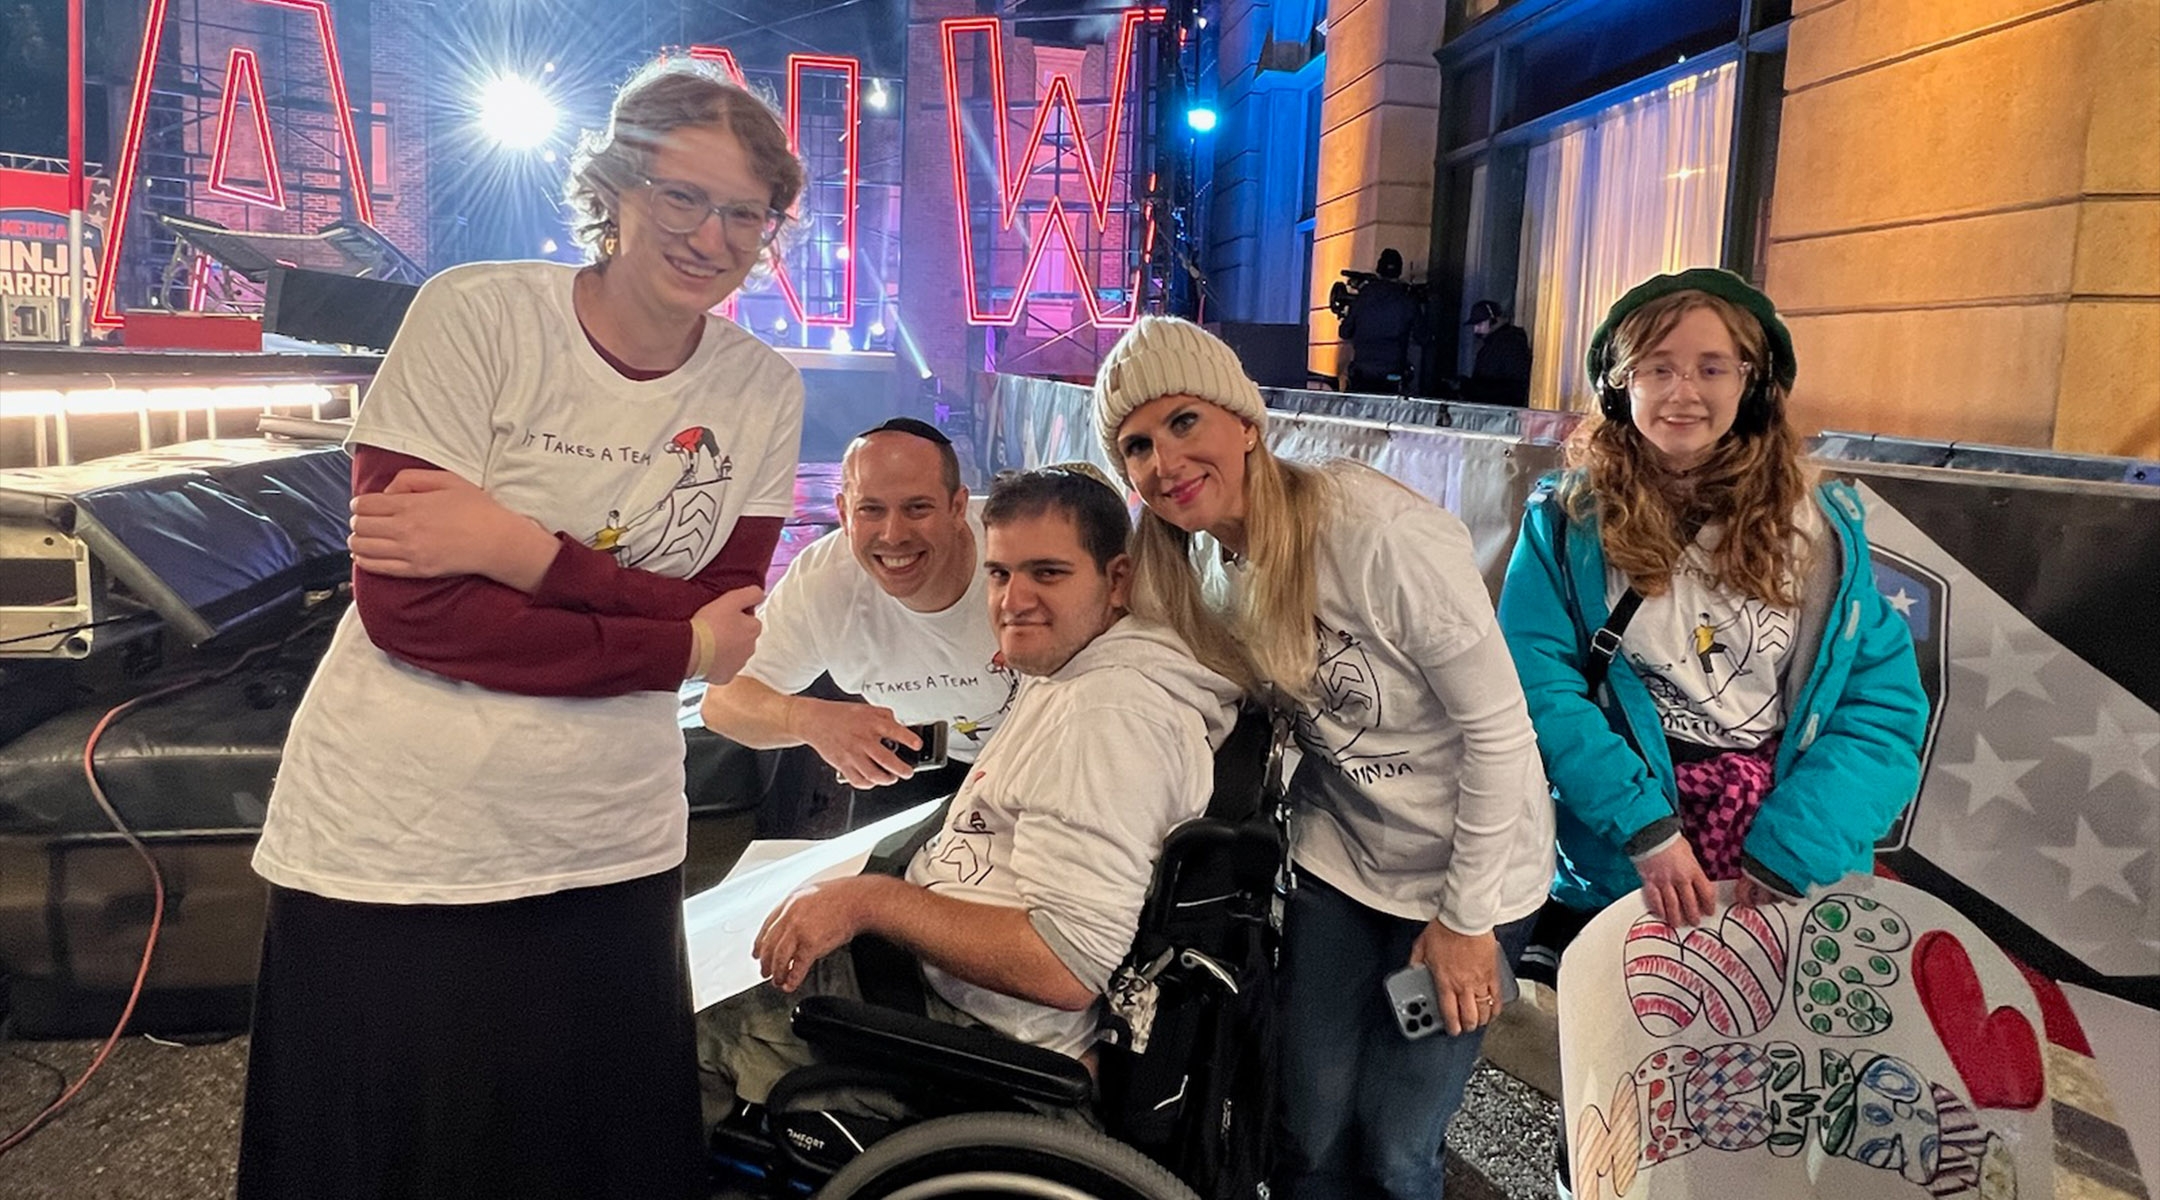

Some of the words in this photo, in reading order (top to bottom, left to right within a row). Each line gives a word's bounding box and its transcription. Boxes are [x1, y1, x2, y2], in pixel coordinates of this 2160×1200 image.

[0, 219, 69, 240] MERICA
[521, 428, 536, 447] IT
[542, 433, 595, 458] TAKES
[601, 447, 613, 462] A
[876, 680, 922, 694] TAKES
[926, 675, 937, 689] A
[940, 674, 979, 688] TEAM
[1624, 894, 1911, 1037] WE
